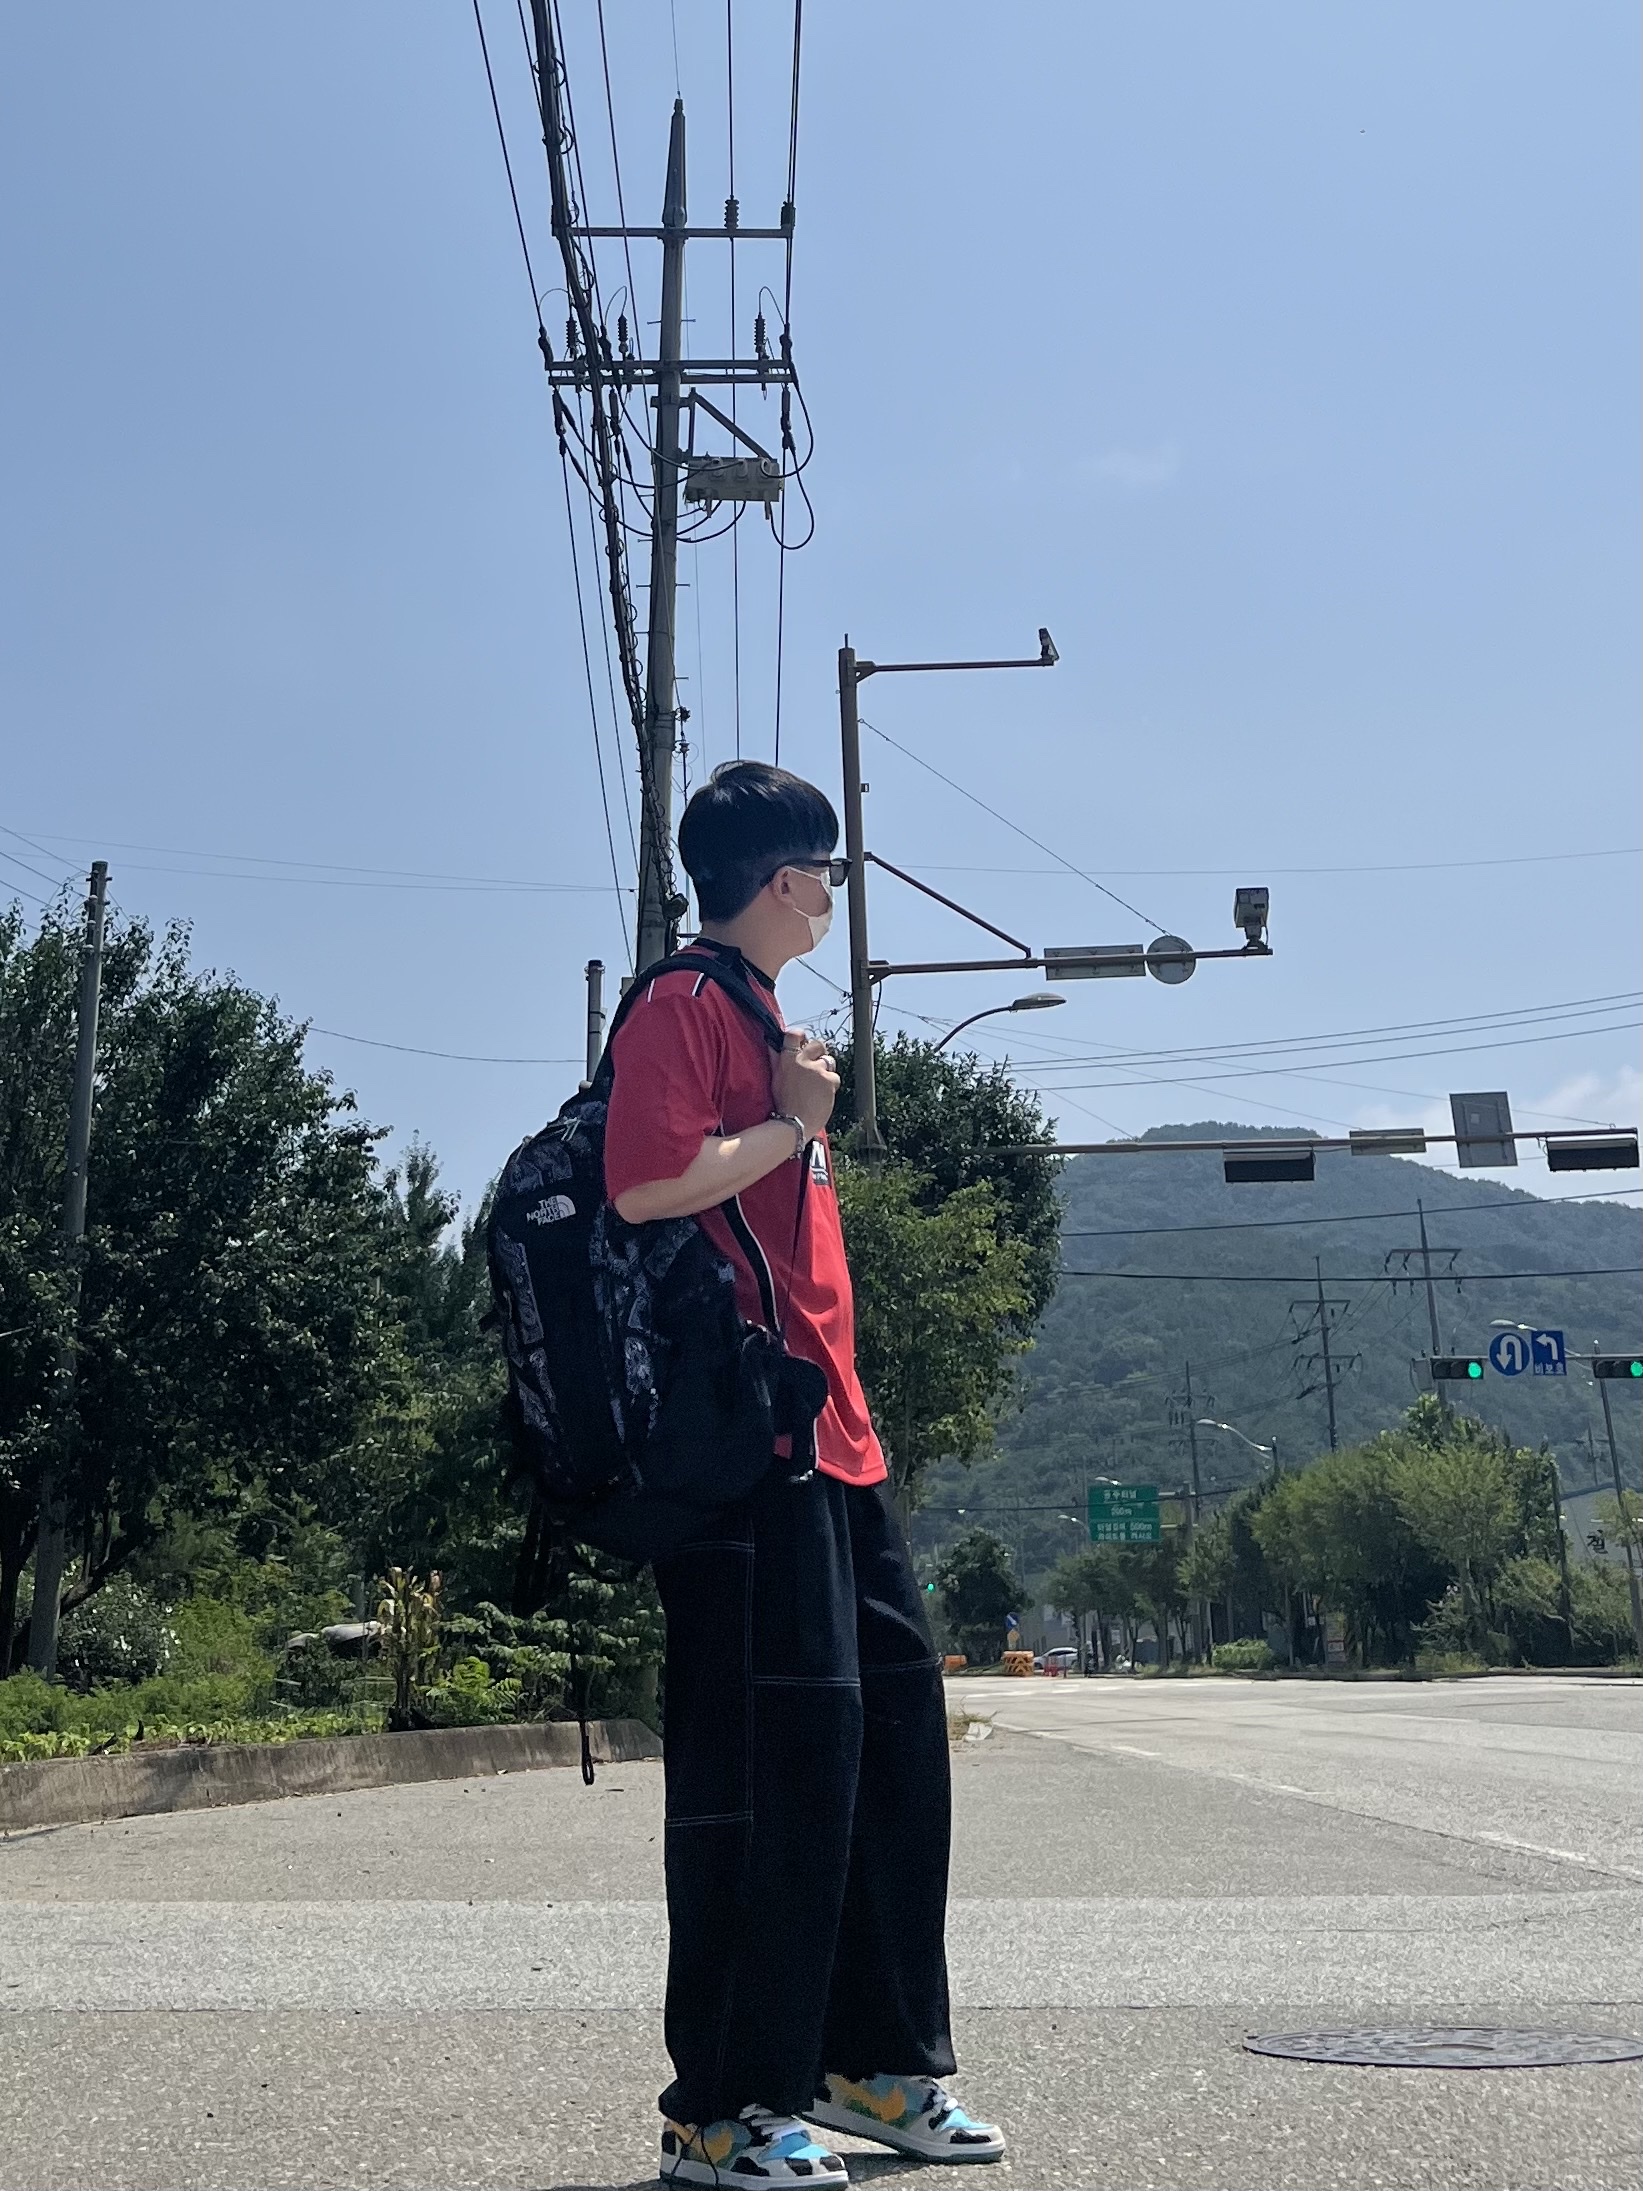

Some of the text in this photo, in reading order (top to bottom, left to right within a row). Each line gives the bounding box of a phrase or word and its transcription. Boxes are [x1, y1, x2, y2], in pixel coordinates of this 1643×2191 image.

[538, 1196, 557, 1209] THE
[526, 1204, 560, 1222] NORTH
[537, 1214, 561, 1226] FACE
[1534, 1362, 1565, 1375] 비보호
